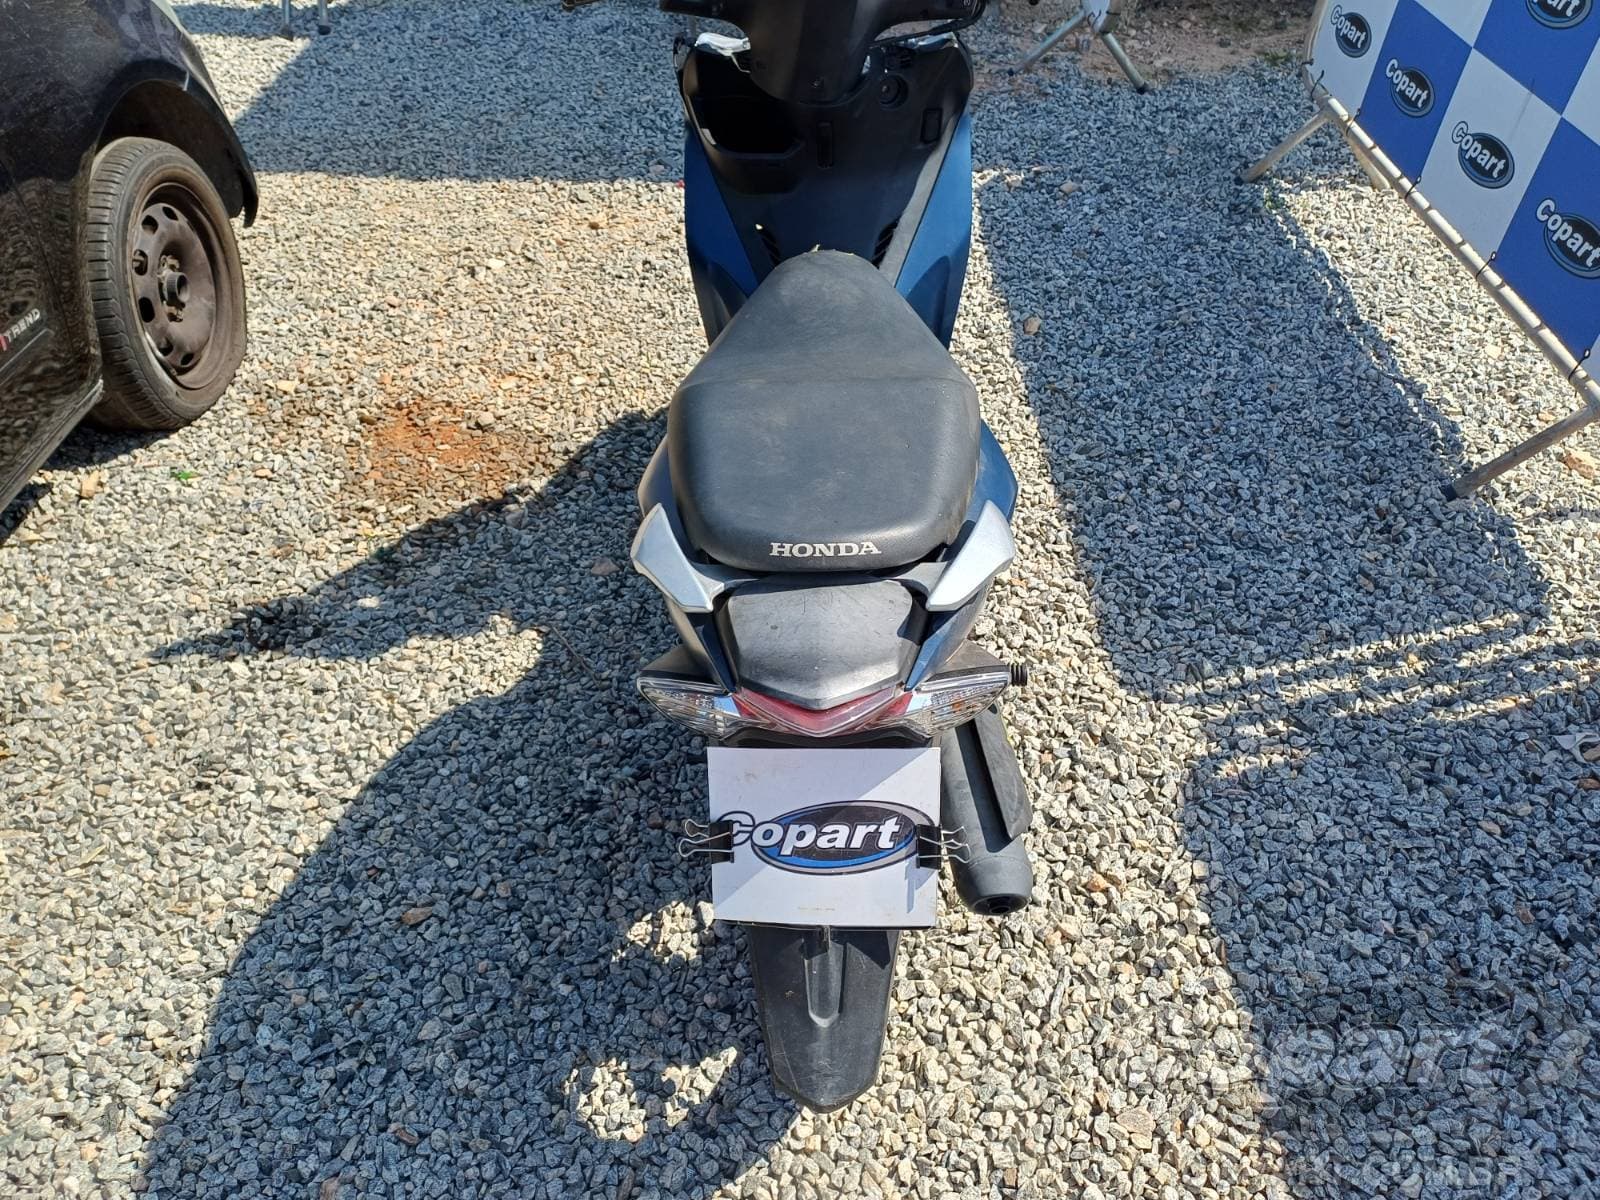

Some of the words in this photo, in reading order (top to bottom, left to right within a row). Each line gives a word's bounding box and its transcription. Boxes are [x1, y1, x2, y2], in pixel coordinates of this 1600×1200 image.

[1331, 5, 1367, 49] Copart
[1386, 58, 1429, 108] Copart
[1452, 121, 1506, 178] Copart
[1536, 198, 1600, 268] Copart
[769, 541, 882, 558] HONDA
